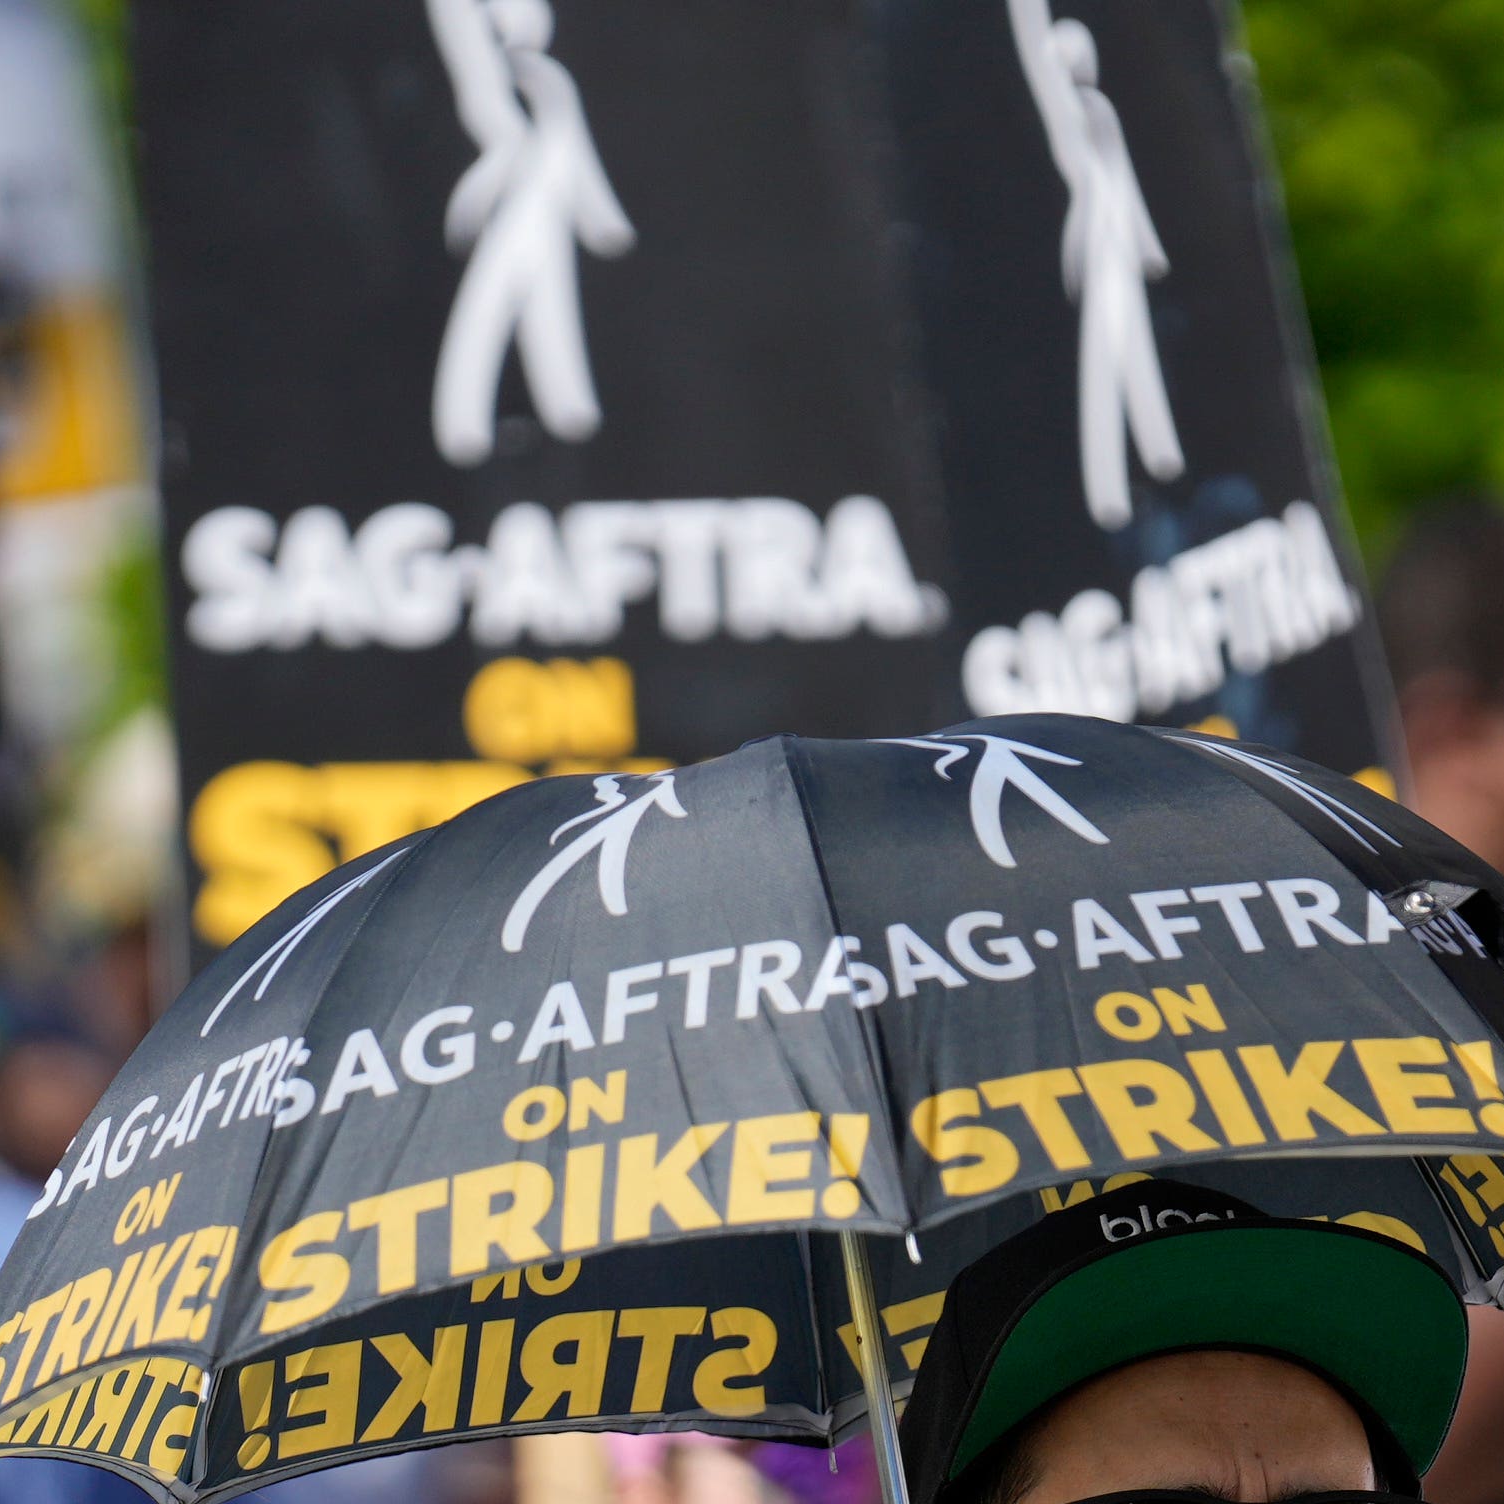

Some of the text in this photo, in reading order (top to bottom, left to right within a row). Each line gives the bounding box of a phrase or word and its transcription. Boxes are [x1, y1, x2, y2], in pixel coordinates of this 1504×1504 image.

[1094, 984, 1226, 1042] ON
[502, 1070, 626, 1141] ON
[113, 1173, 182, 1244] ON
[259, 1111, 870, 1334] STRIKE!
